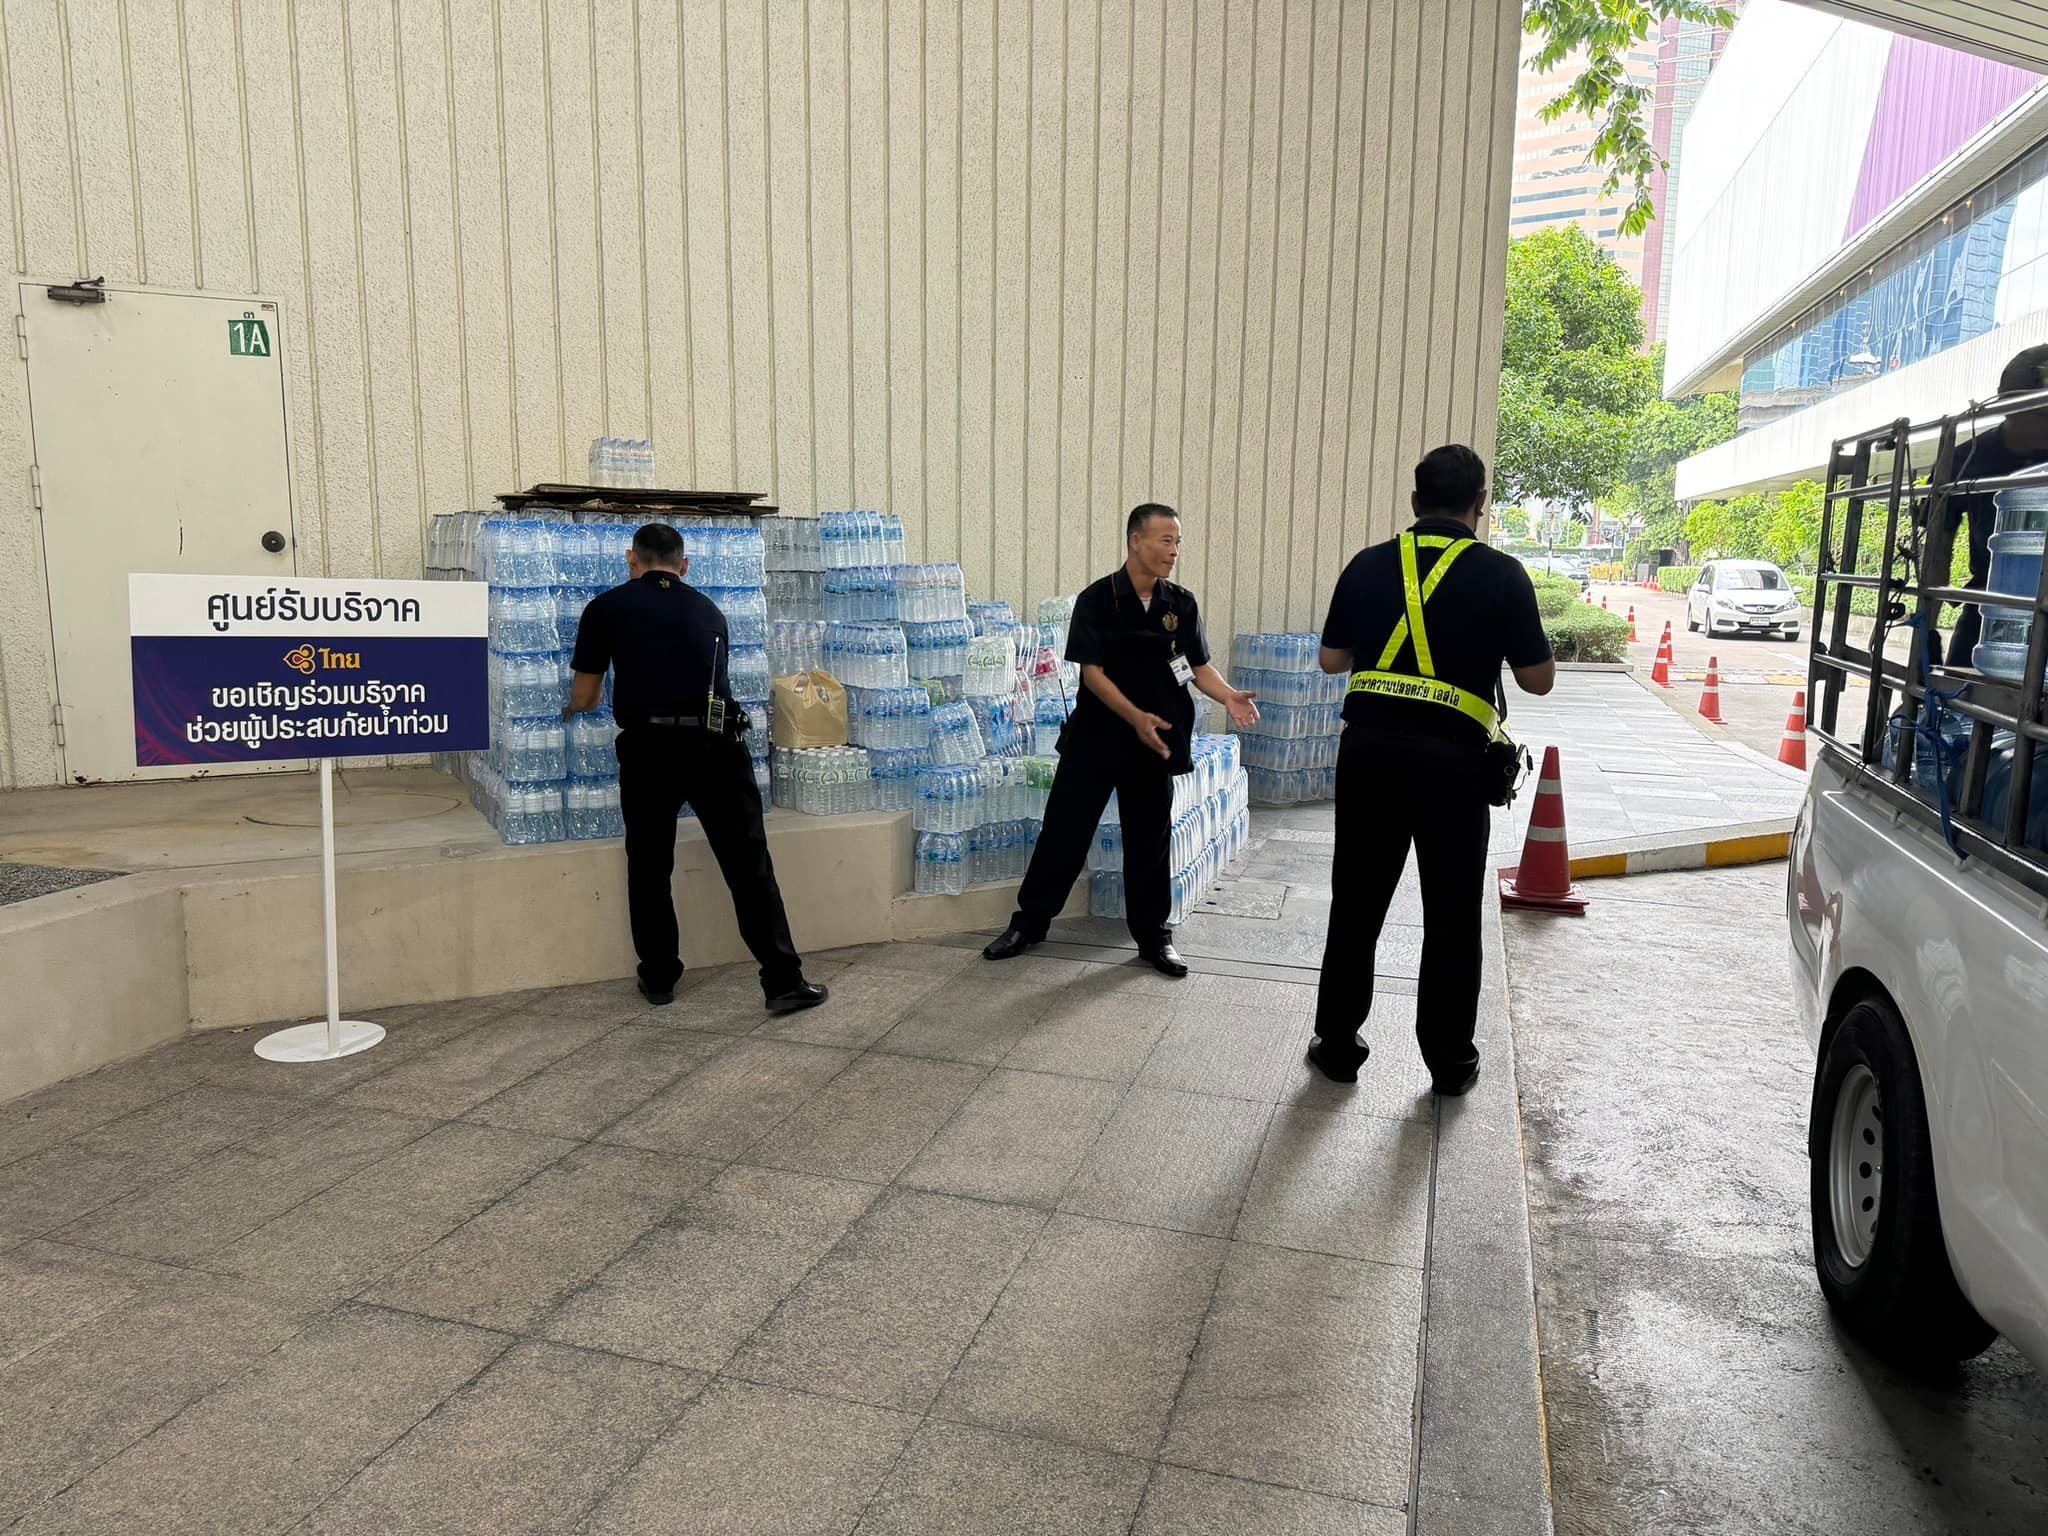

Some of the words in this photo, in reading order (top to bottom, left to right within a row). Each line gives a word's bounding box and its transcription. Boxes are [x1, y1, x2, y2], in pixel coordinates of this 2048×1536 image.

[233, 322, 267, 354] 1A
[207, 587, 420, 632] ศูนย์รับบริจาค
[318, 647, 361, 669] ไทย
[211, 680, 426, 711] ขอเชิญร่วมบริจาค
[186, 705, 449, 749] ช่วยผู้ประสบภัยน้ำท่วม
